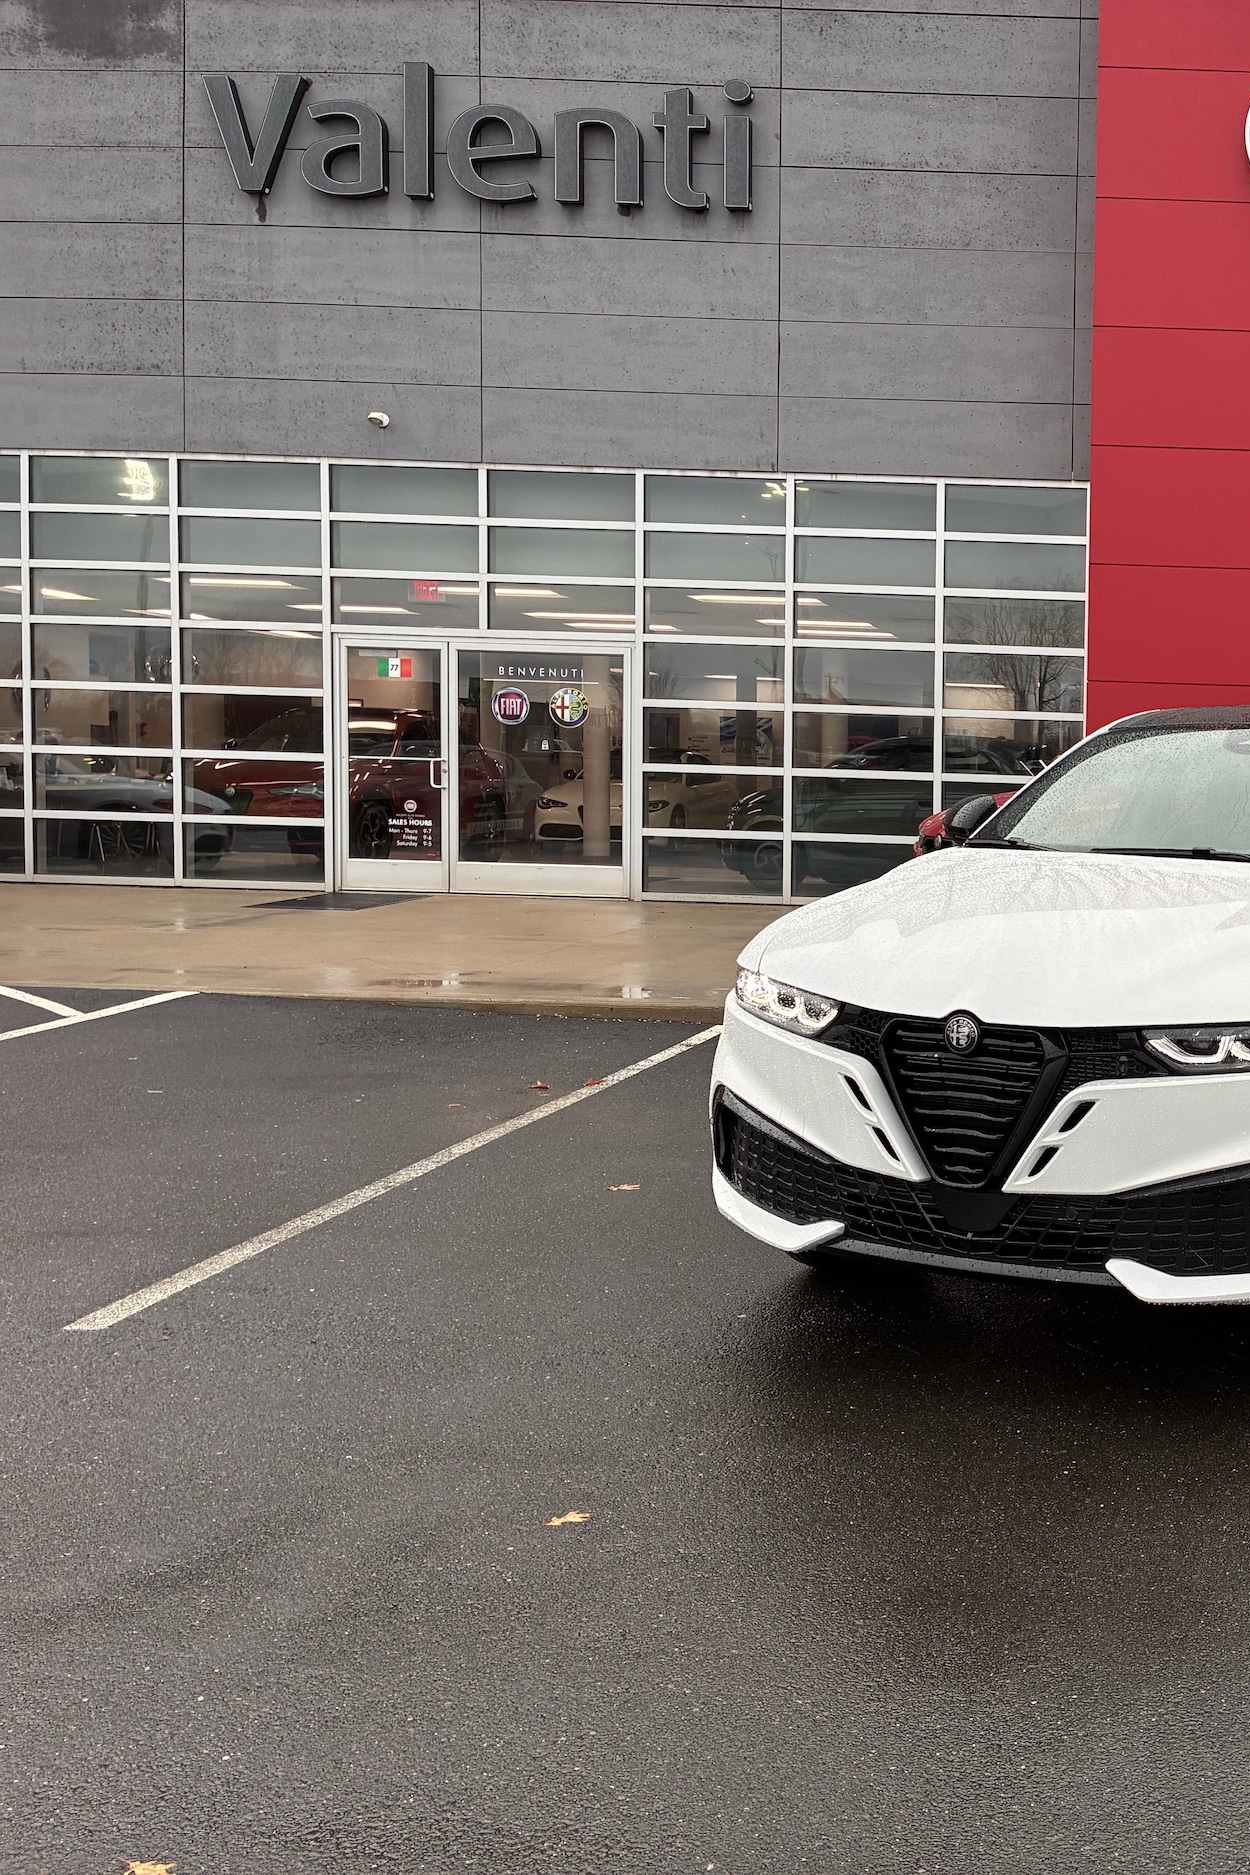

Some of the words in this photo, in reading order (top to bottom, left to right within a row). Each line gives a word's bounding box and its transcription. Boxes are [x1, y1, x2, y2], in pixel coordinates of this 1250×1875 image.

[200, 61, 756, 213] Valenti
[498, 666, 584, 678] BENVENUTI
[500, 698, 522, 715] FIAT
